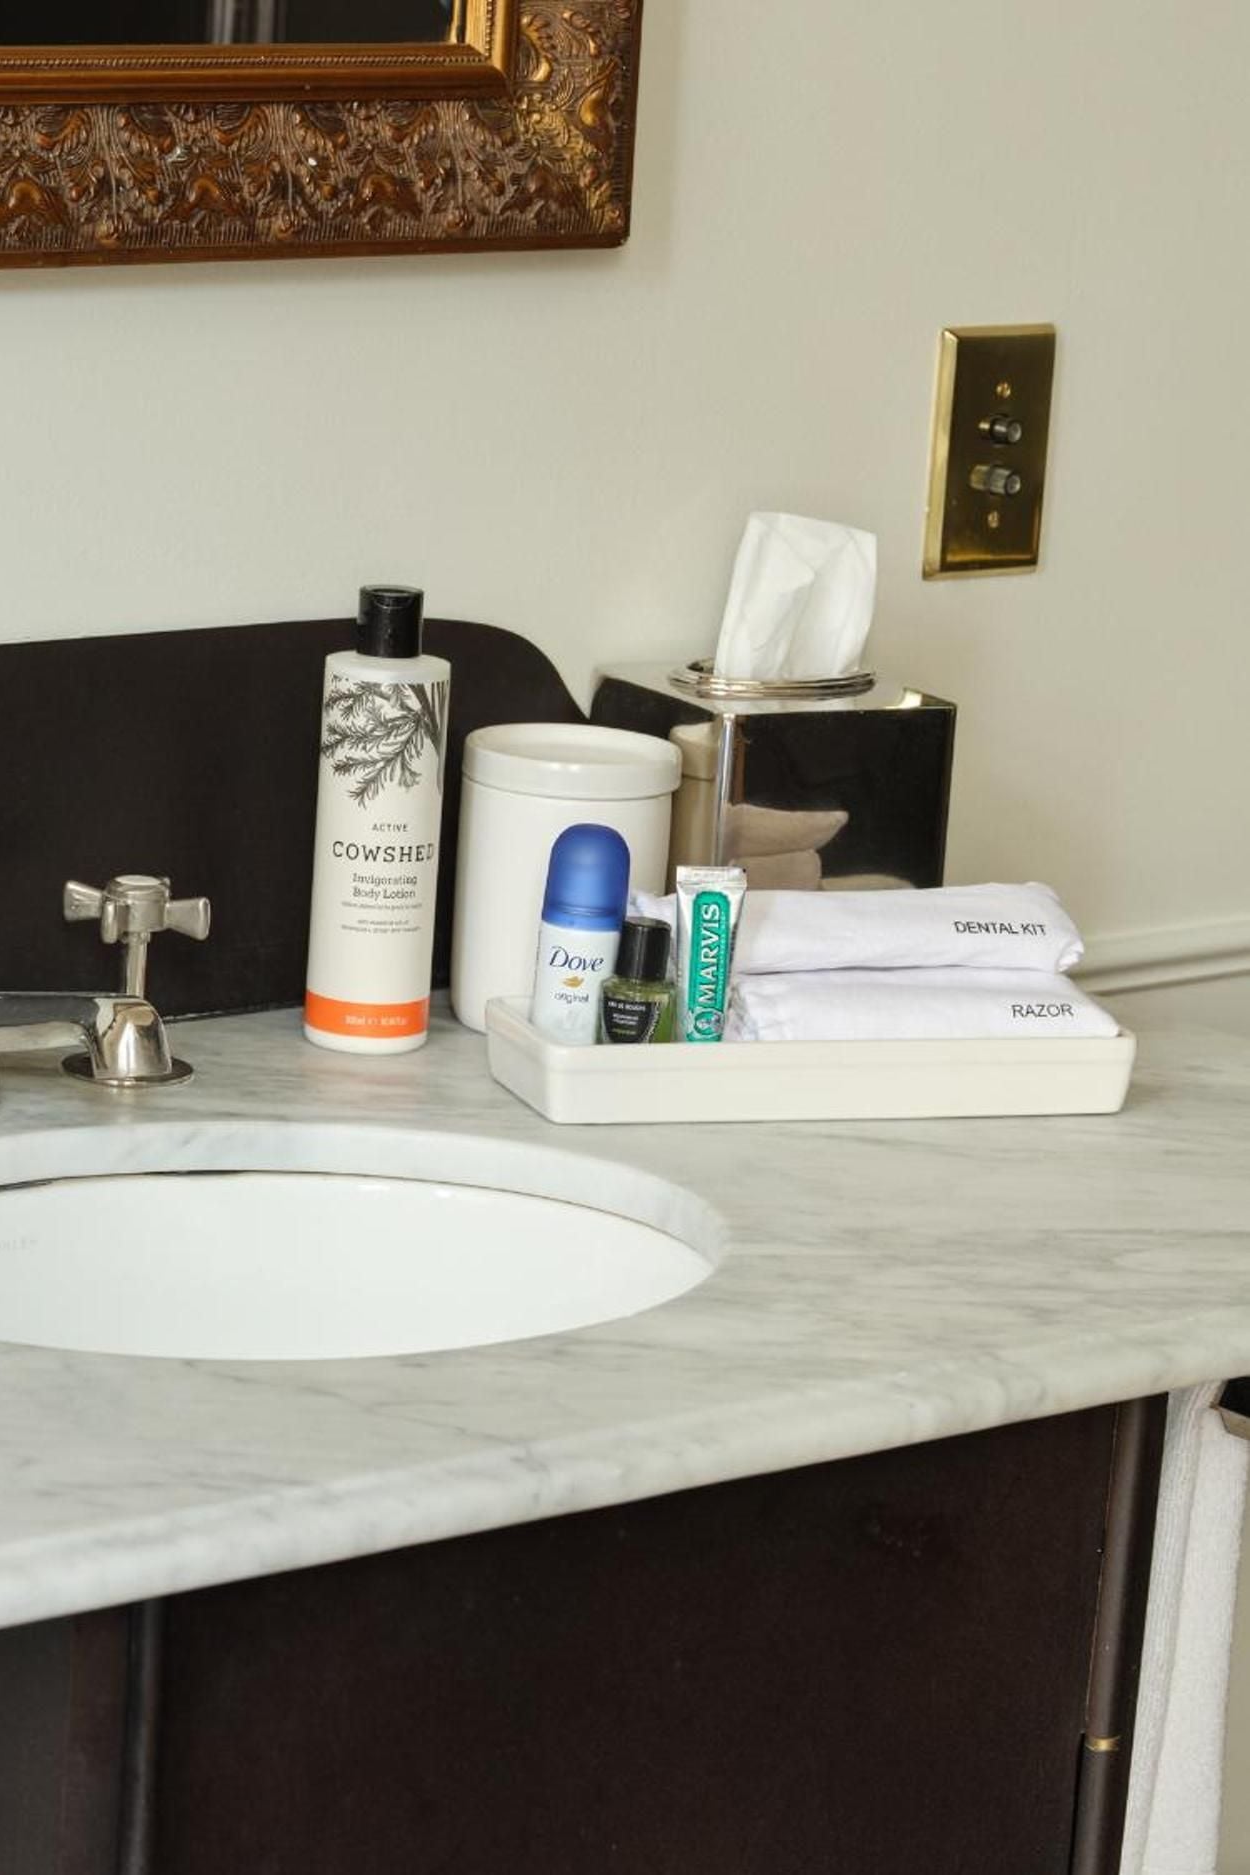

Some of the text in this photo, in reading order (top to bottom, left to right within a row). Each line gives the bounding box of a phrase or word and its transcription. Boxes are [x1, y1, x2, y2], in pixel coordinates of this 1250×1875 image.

[371, 823, 409, 833] ACTIVE
[332, 840, 435, 863] COWSHED
[352, 873, 418, 887] Invigorating
[352, 887, 417, 901] Body Lotion
[953, 920, 1047, 936] DENTAL KIT
[549, 945, 605, 972] Dove
[699, 904, 720, 1005] MARVIS
[554, 992, 590, 1004] original
[1011, 1003, 1075, 1018] RAZOR
